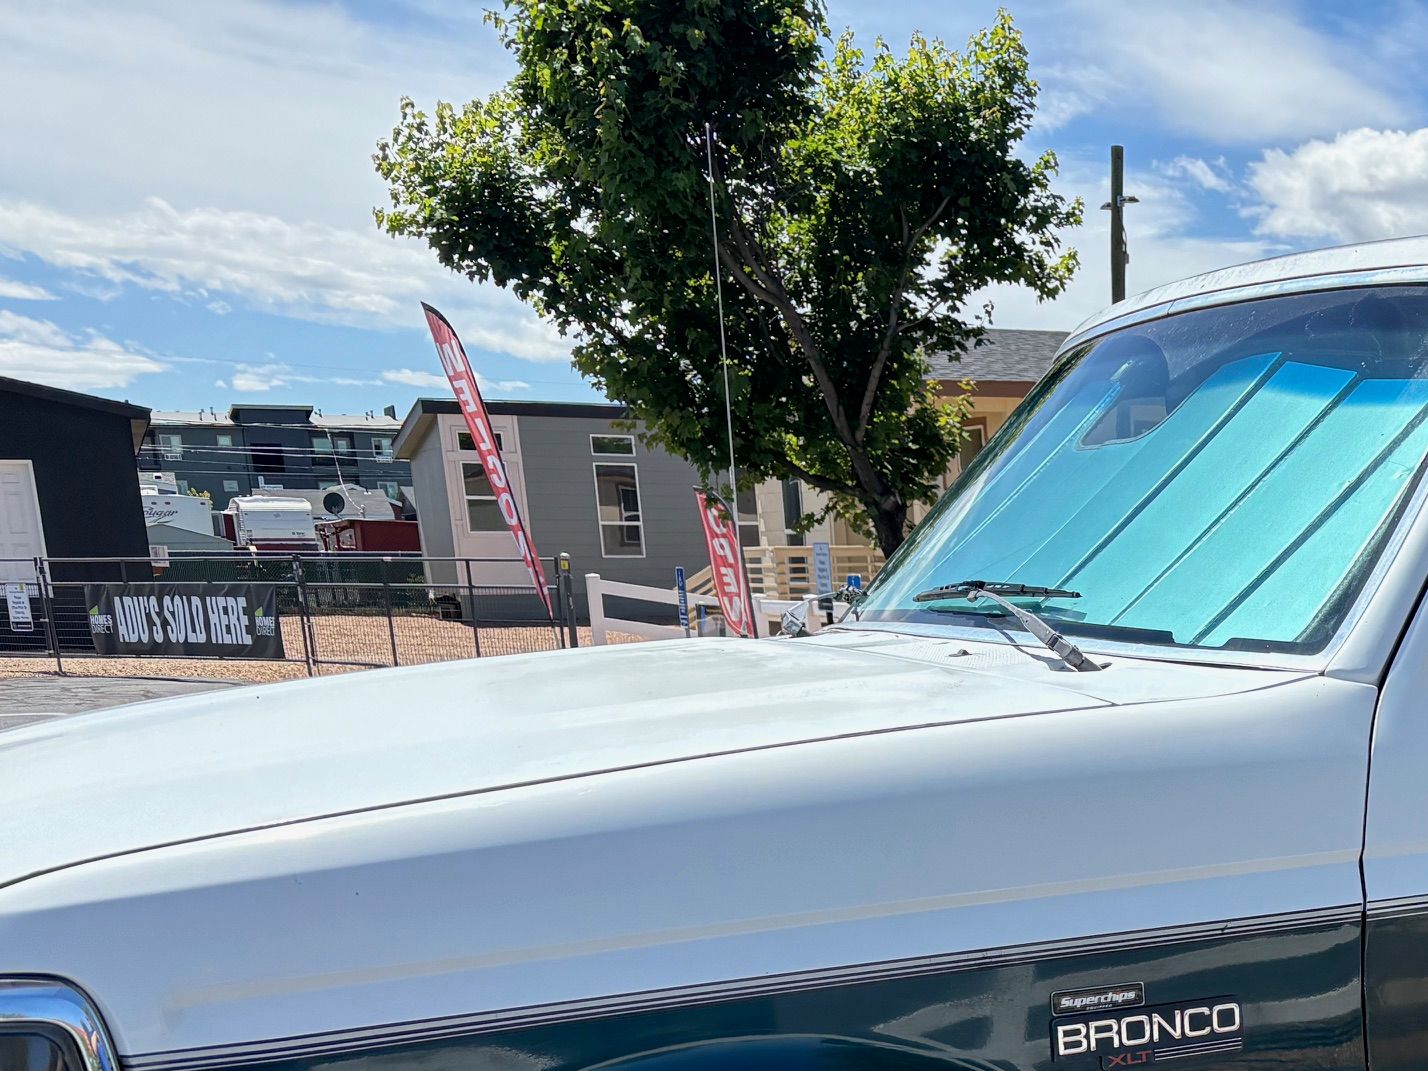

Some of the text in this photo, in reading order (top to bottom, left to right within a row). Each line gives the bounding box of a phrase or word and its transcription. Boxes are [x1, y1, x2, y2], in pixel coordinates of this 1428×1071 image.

[90, 614, 113, 625] HOMES
[113, 595, 253, 645] ADU'S SOLD HERE
[91, 625, 114, 634] DIRECT
[1059, 990, 1136, 1009] Superchips
[1057, 1002, 1240, 1056] BRONCO
[1108, 1050, 1152, 1068] XLT
